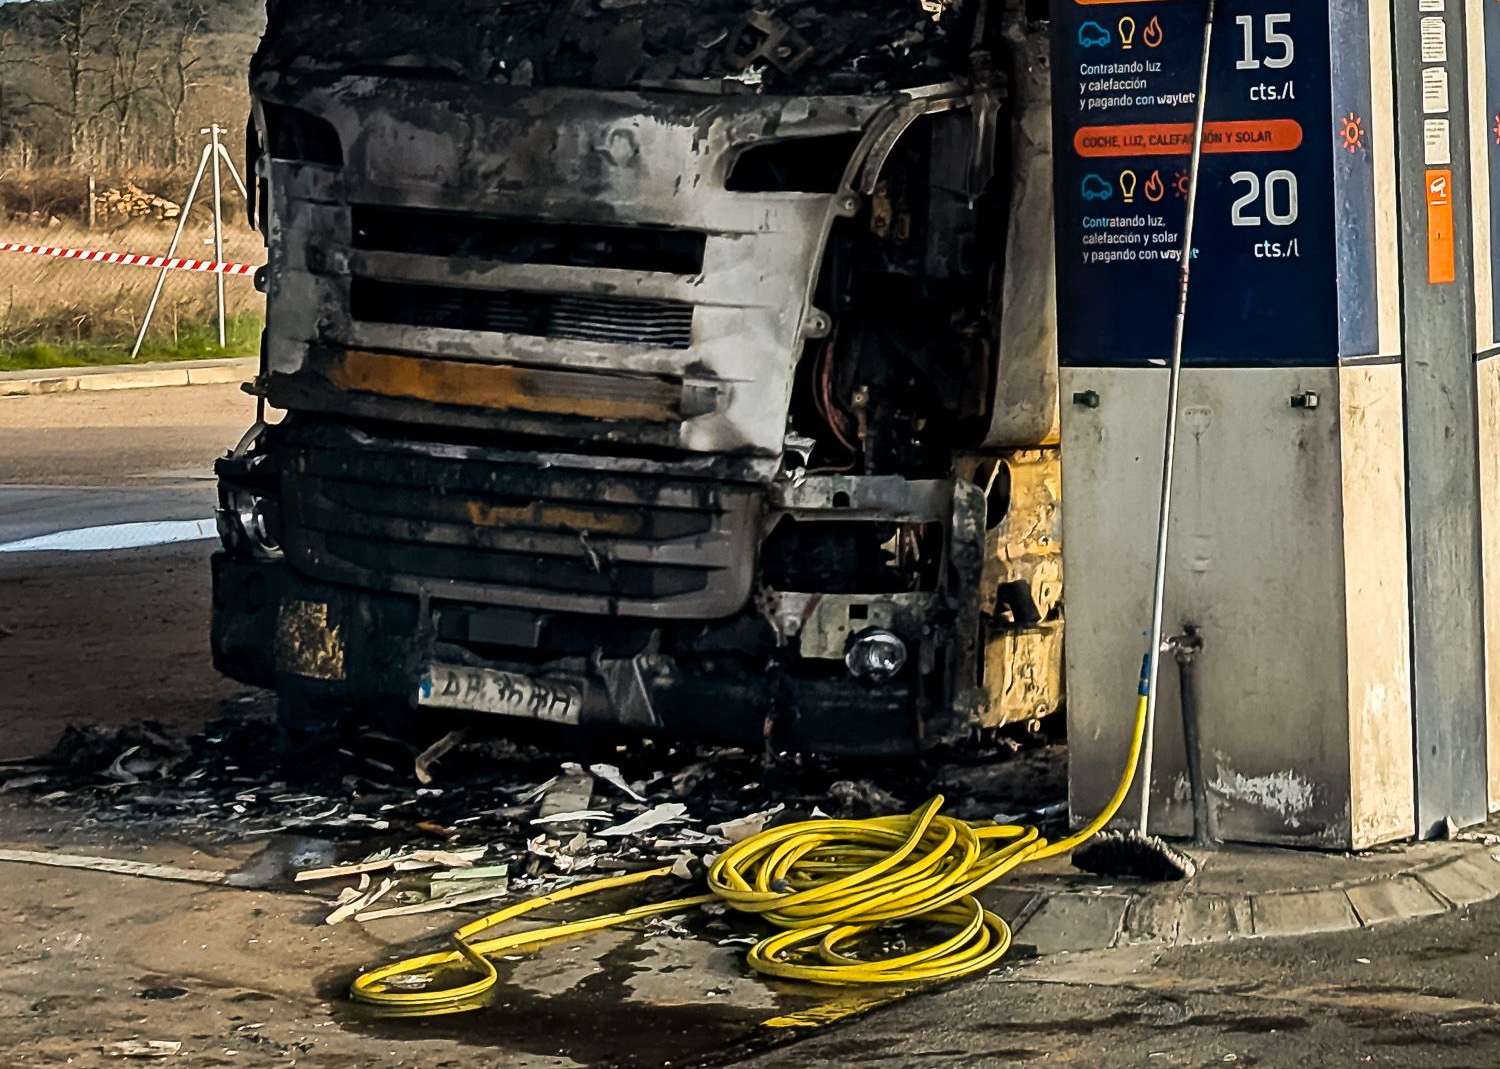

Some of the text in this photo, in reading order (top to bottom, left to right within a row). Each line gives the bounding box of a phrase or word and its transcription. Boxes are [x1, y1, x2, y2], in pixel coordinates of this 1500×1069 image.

[1235, 13, 1295, 70] 15
[1080, 60, 1161, 75] Contratando luz
[1080, 77, 1147, 95] y calefacción
[1080, 98, 1086, 110] y
[1088, 94, 1133, 110] pagando
[1135, 95, 1155, 105] con
[1224, 131, 1233, 143] Y
[1235, 130, 1272, 143] SOLAR
[1230, 169, 1299, 227] 20
[1083, 214, 1145, 228] Contratando
[1083, 230, 1178, 246] calefacción y solar
[1083, 247, 1199, 264] y pagando con wayt
